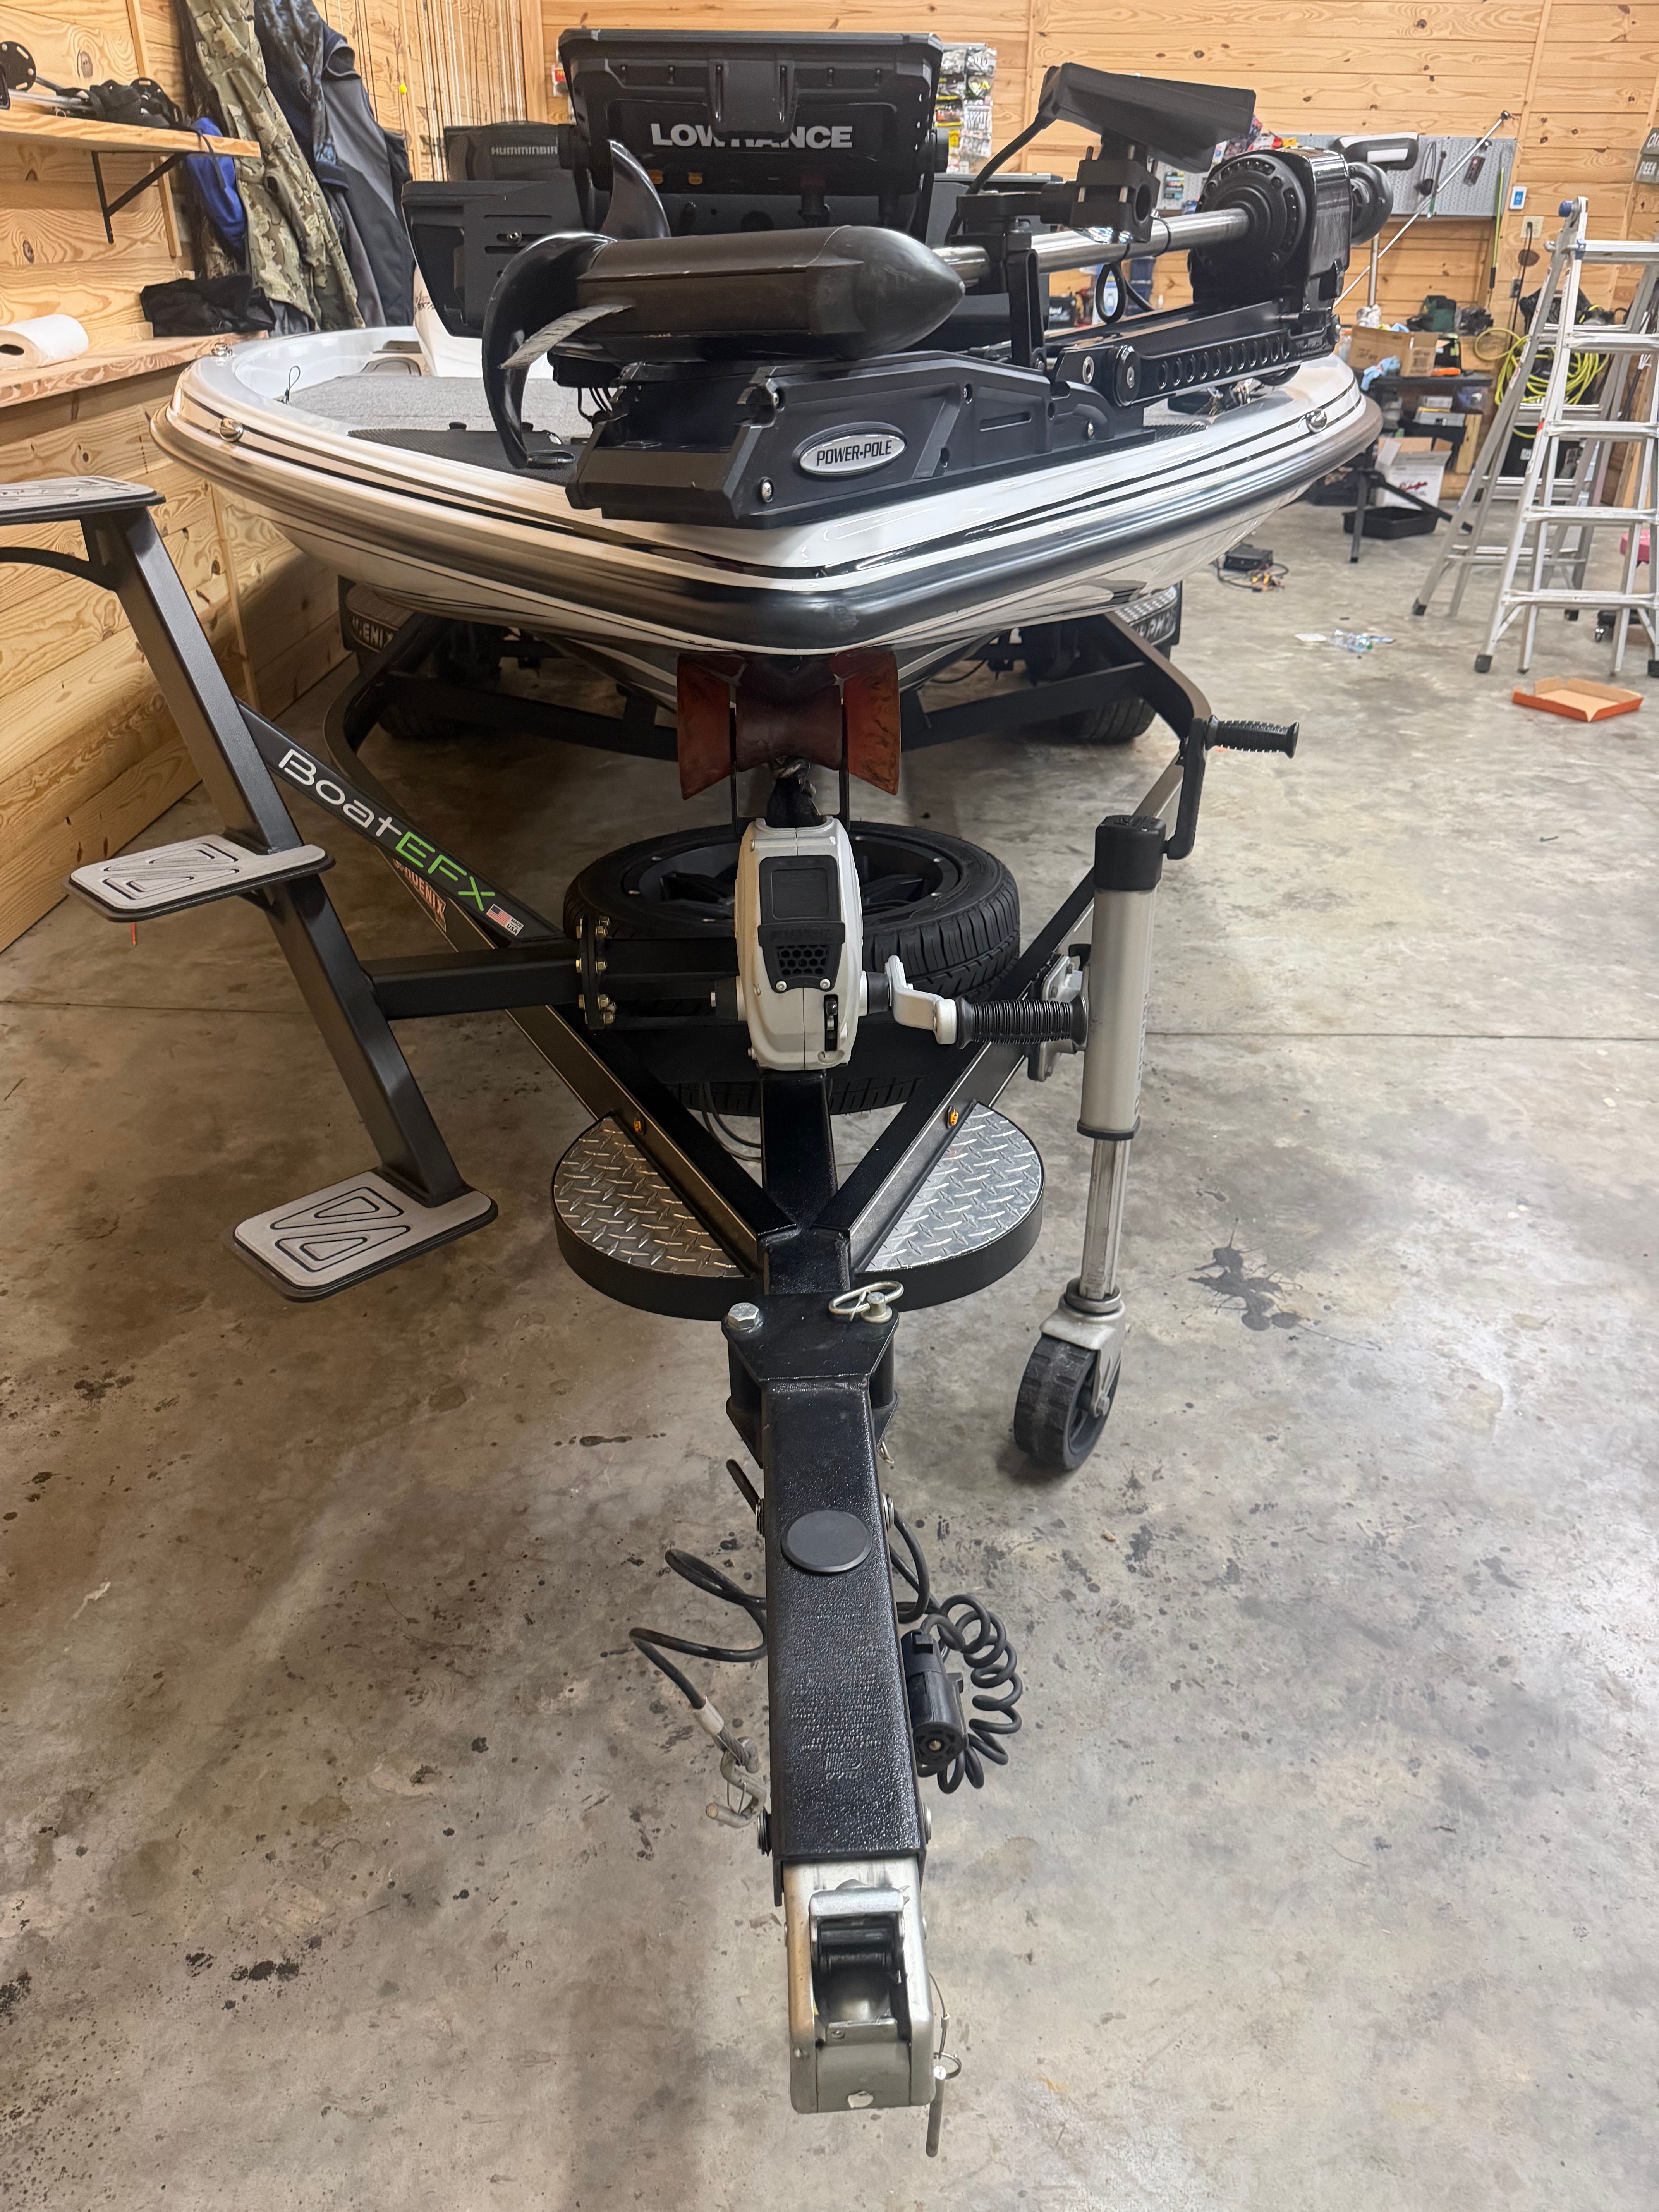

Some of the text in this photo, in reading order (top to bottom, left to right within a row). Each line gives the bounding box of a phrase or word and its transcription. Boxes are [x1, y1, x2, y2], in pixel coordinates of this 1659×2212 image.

[651, 123, 852, 149] LOWNCE
[491, 146, 558, 155] HUMMINBIR
[507, 924, 517, 934] USA
